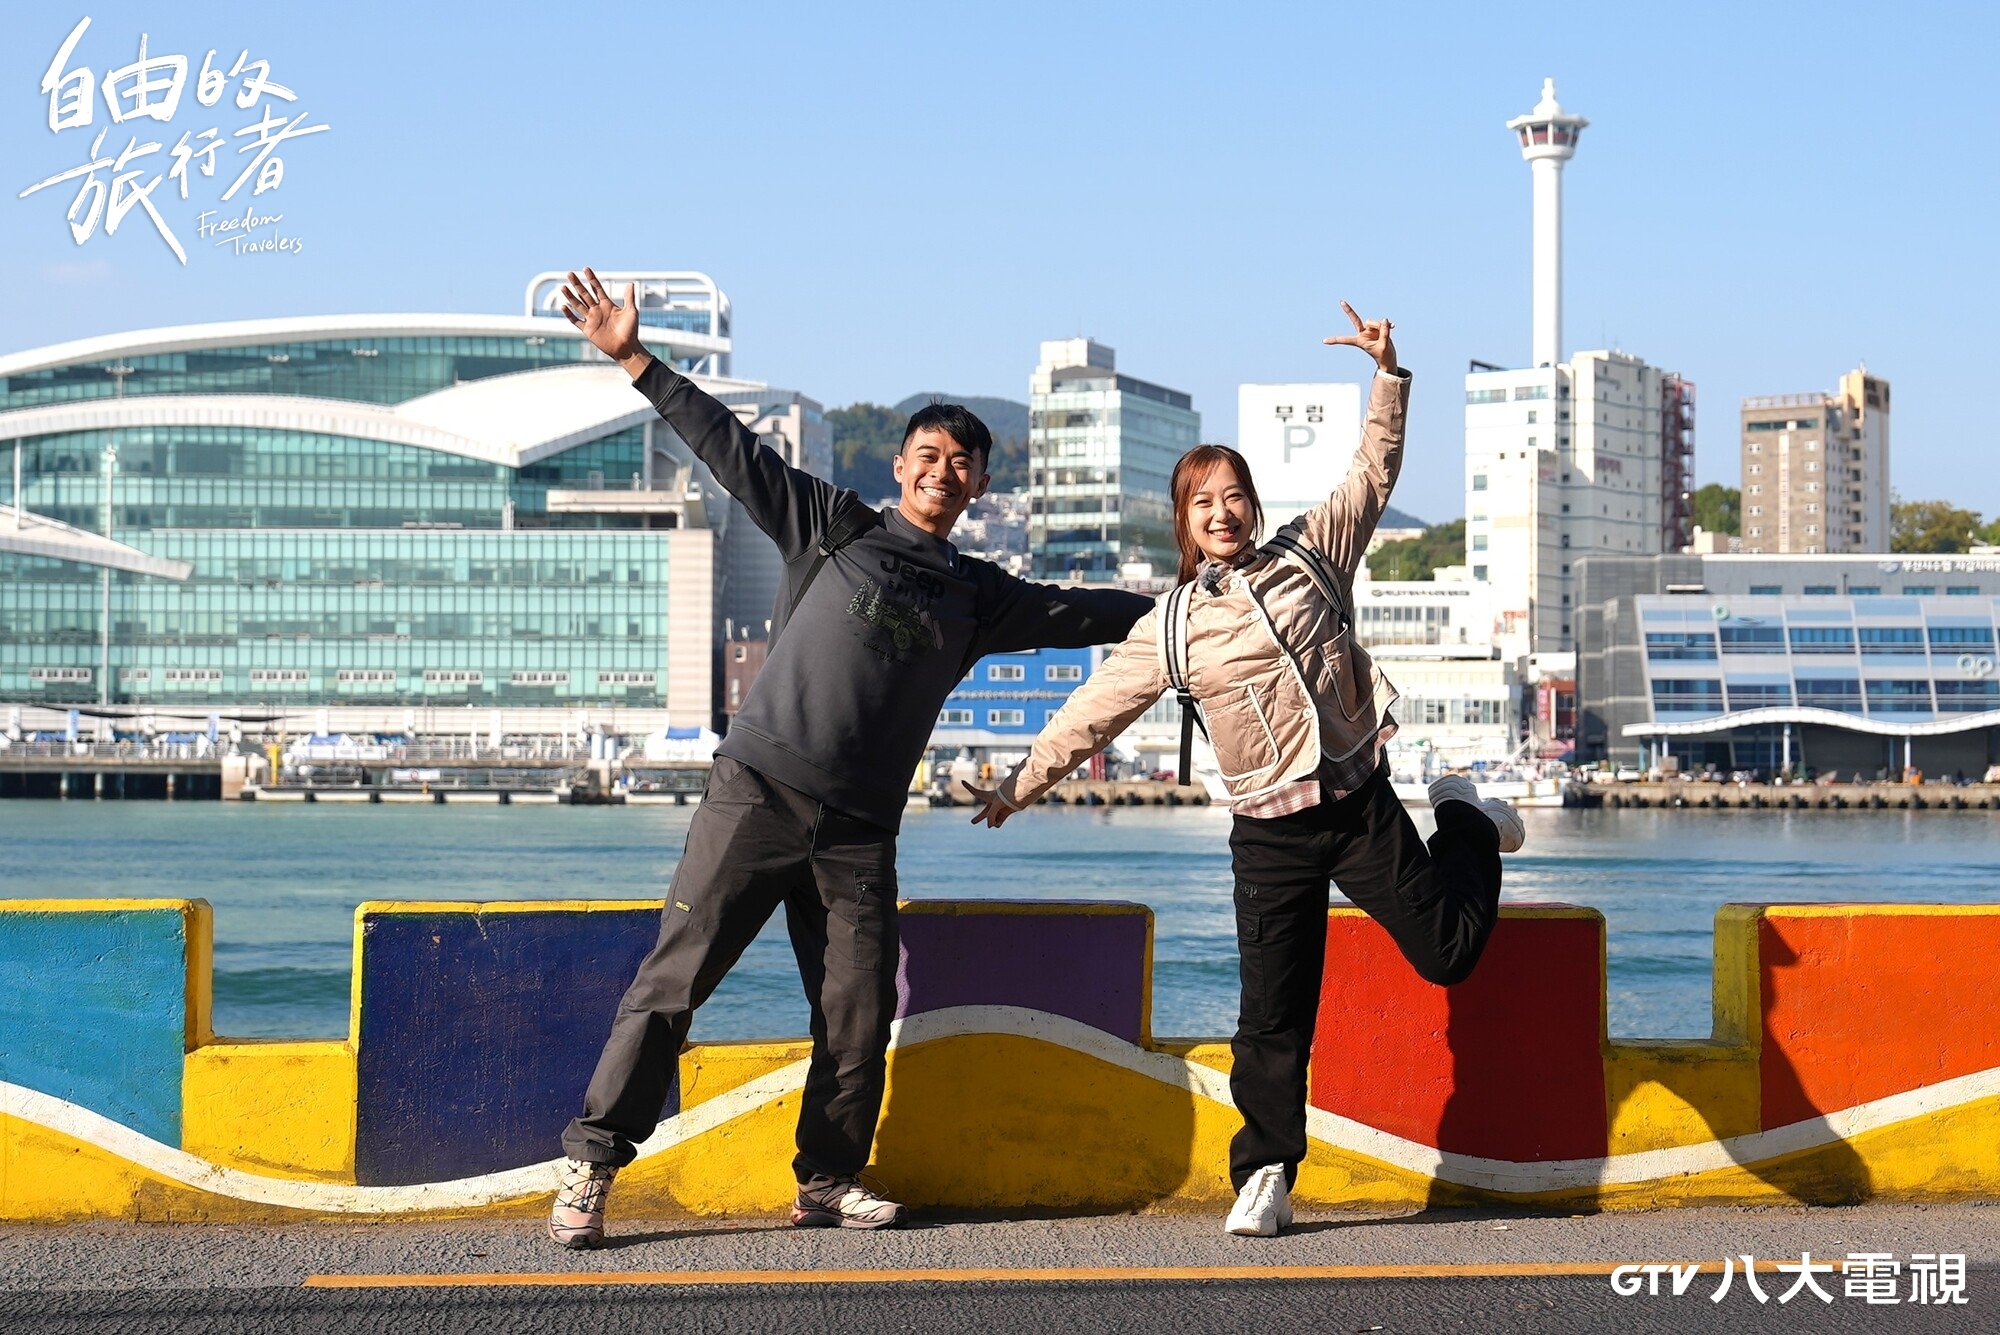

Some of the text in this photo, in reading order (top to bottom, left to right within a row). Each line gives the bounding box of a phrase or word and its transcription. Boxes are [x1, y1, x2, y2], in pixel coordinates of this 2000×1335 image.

[1275, 404, 1324, 423] 부림
[1283, 425, 1316, 463] P
[880, 552, 946, 599] Jeep
